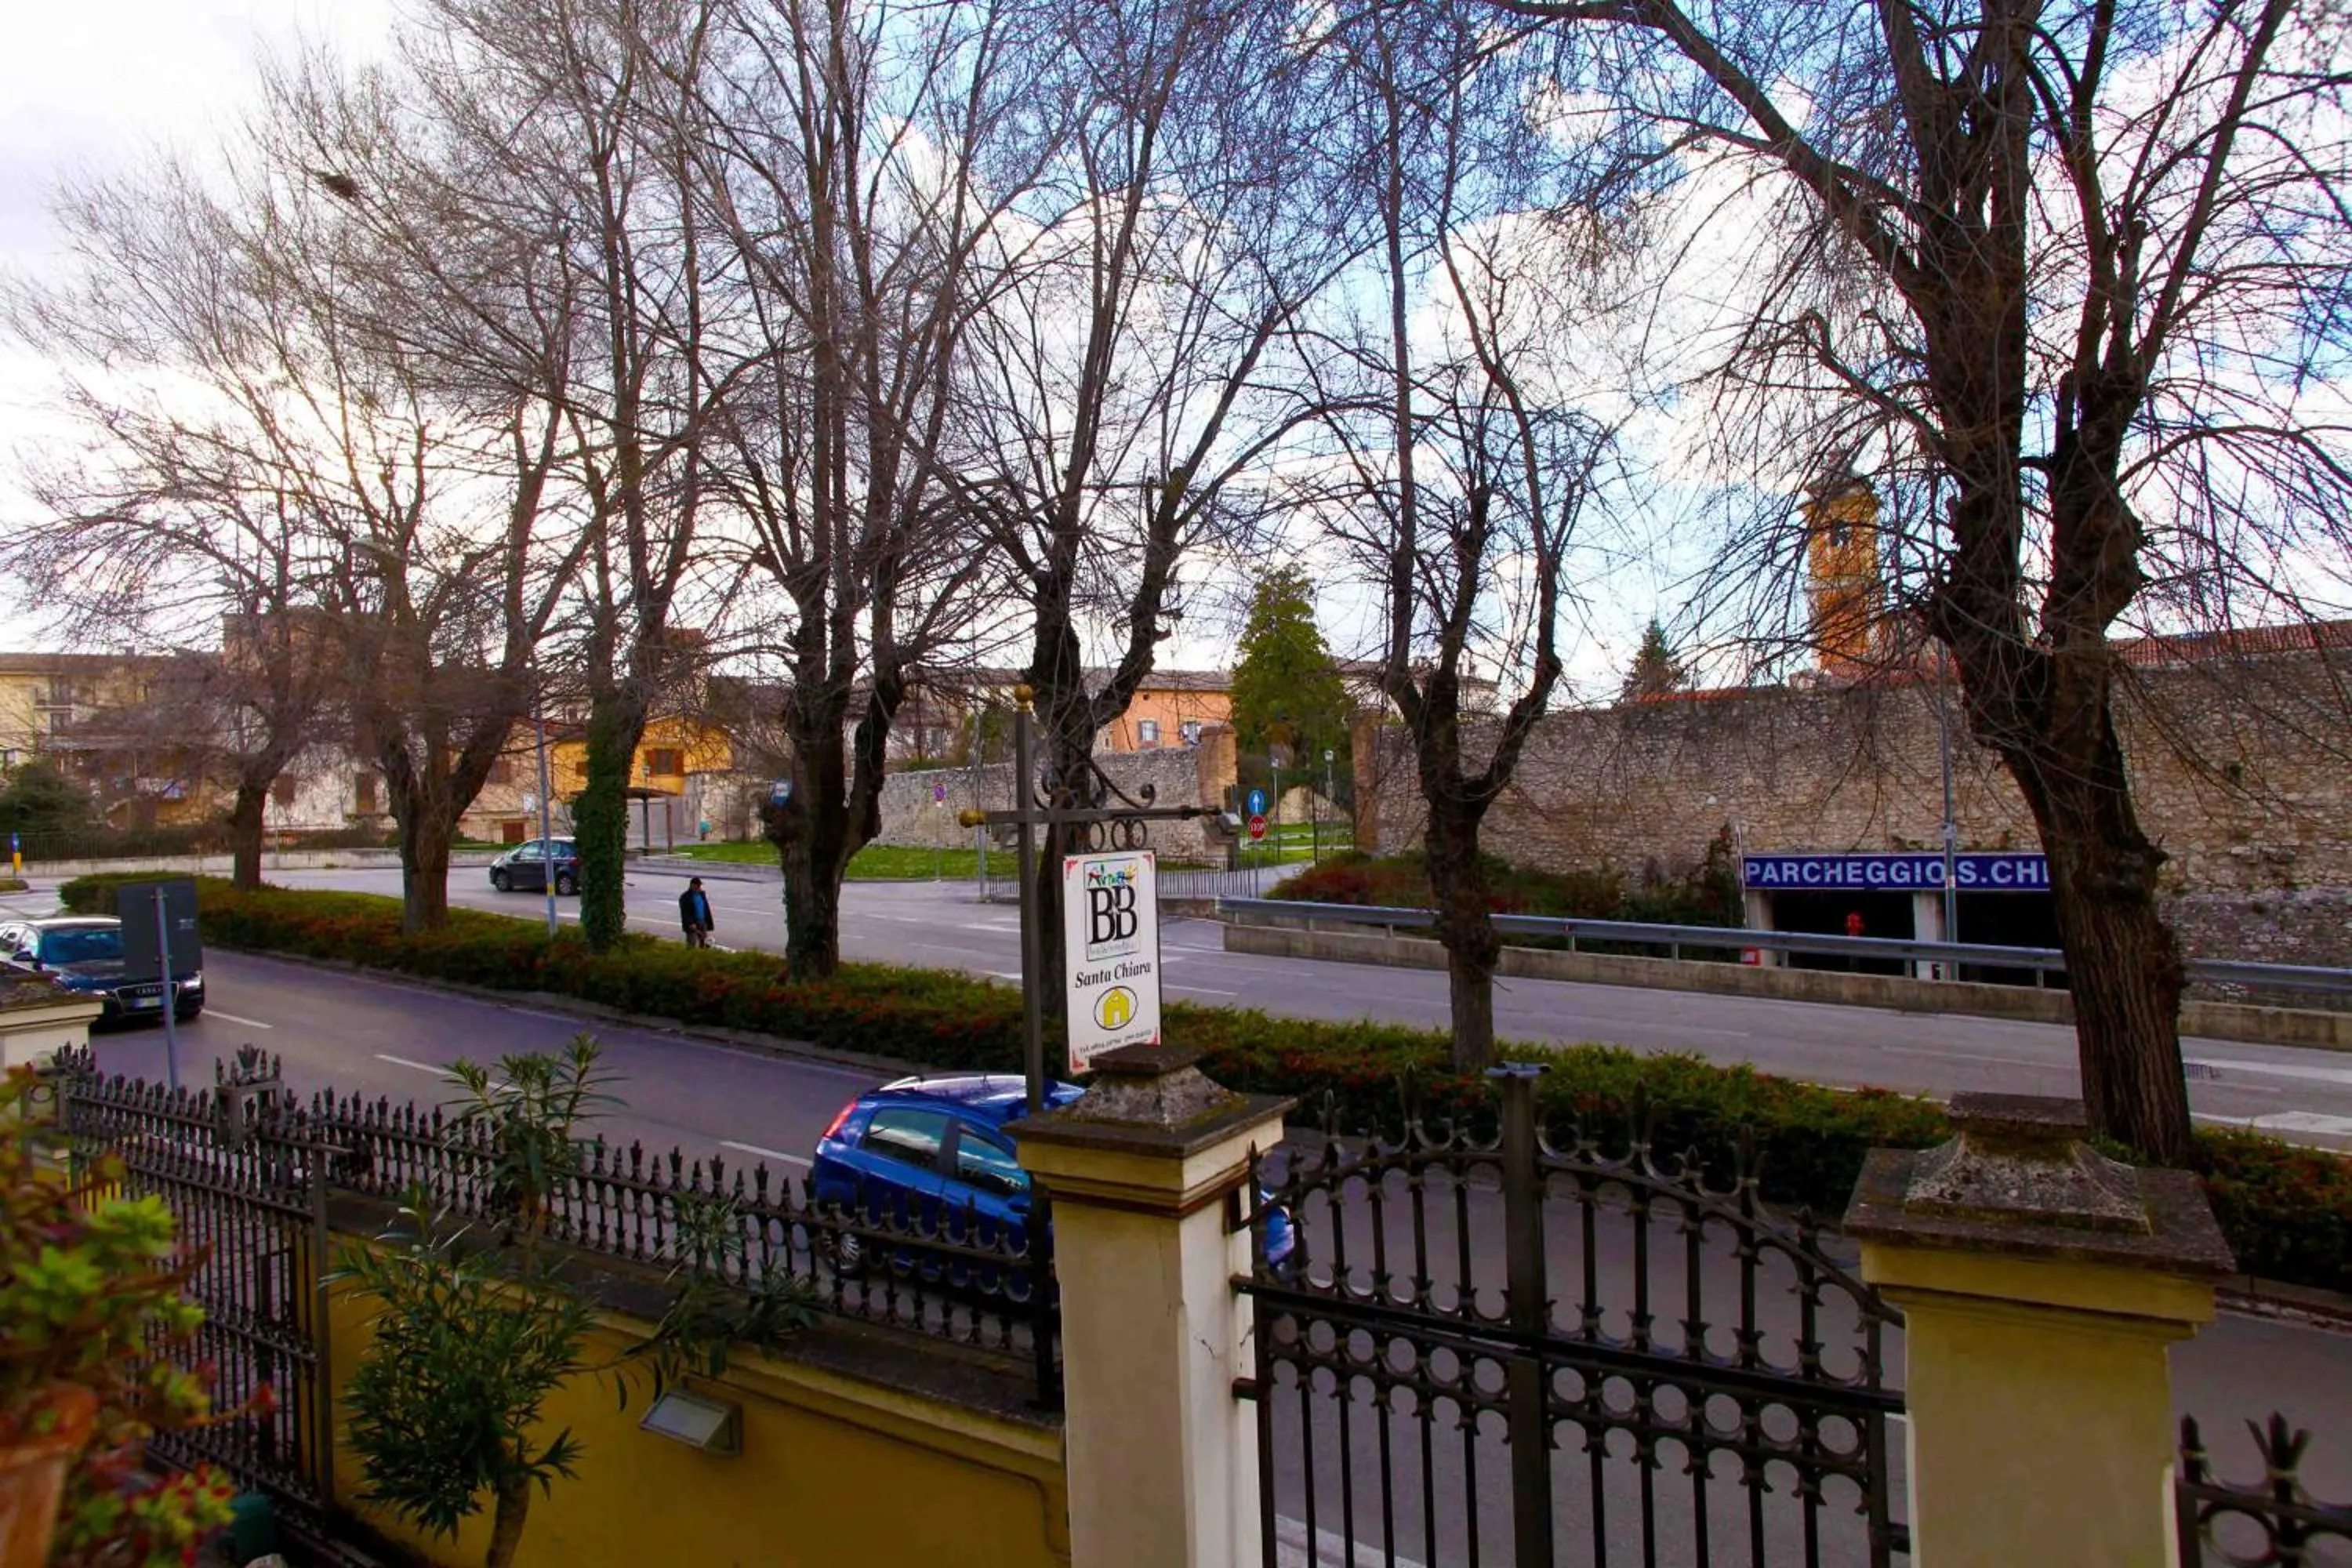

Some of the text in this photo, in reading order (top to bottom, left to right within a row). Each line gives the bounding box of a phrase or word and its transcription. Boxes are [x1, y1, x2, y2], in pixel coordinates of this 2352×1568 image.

[1745, 861, 1946, 884] PARCHEGGIO
[1075, 960, 1151, 988] Santa Chiara
